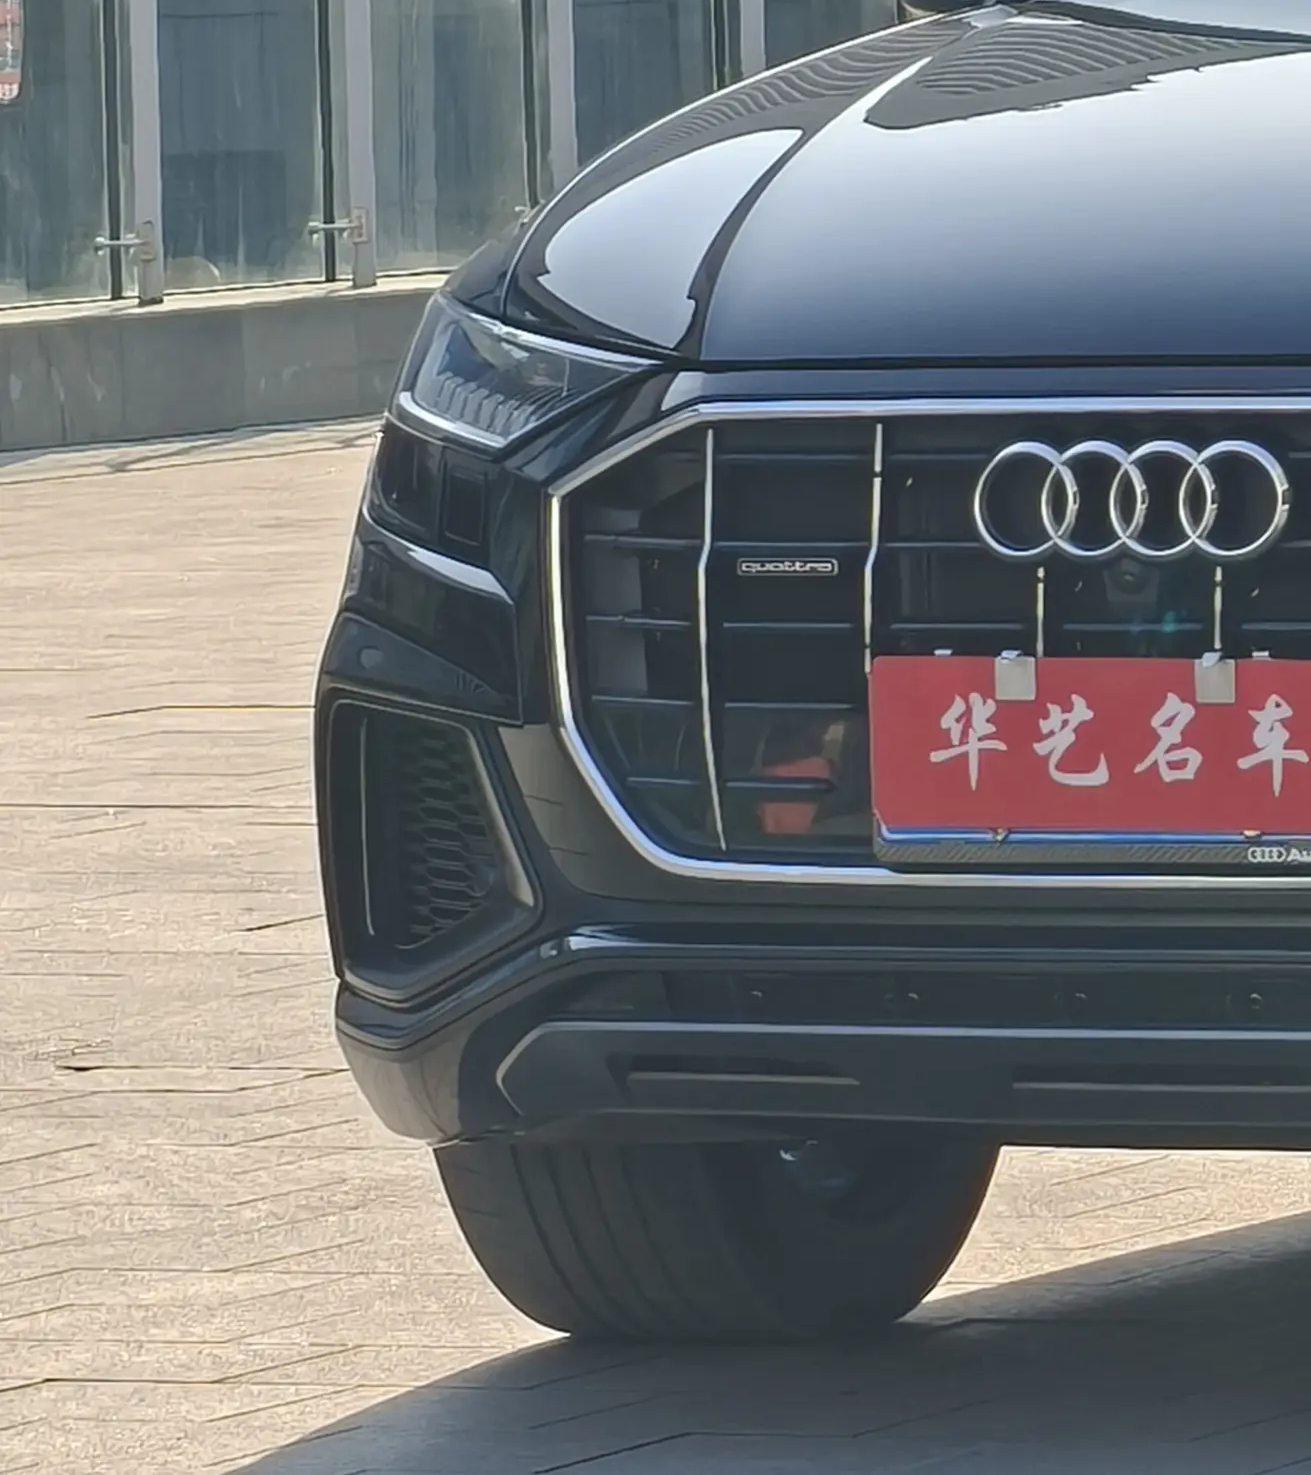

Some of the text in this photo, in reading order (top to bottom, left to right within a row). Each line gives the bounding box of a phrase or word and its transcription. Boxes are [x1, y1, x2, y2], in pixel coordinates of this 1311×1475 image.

[741, 560, 833, 573] quattro
[929, 691, 1310, 798] 华艺名车
